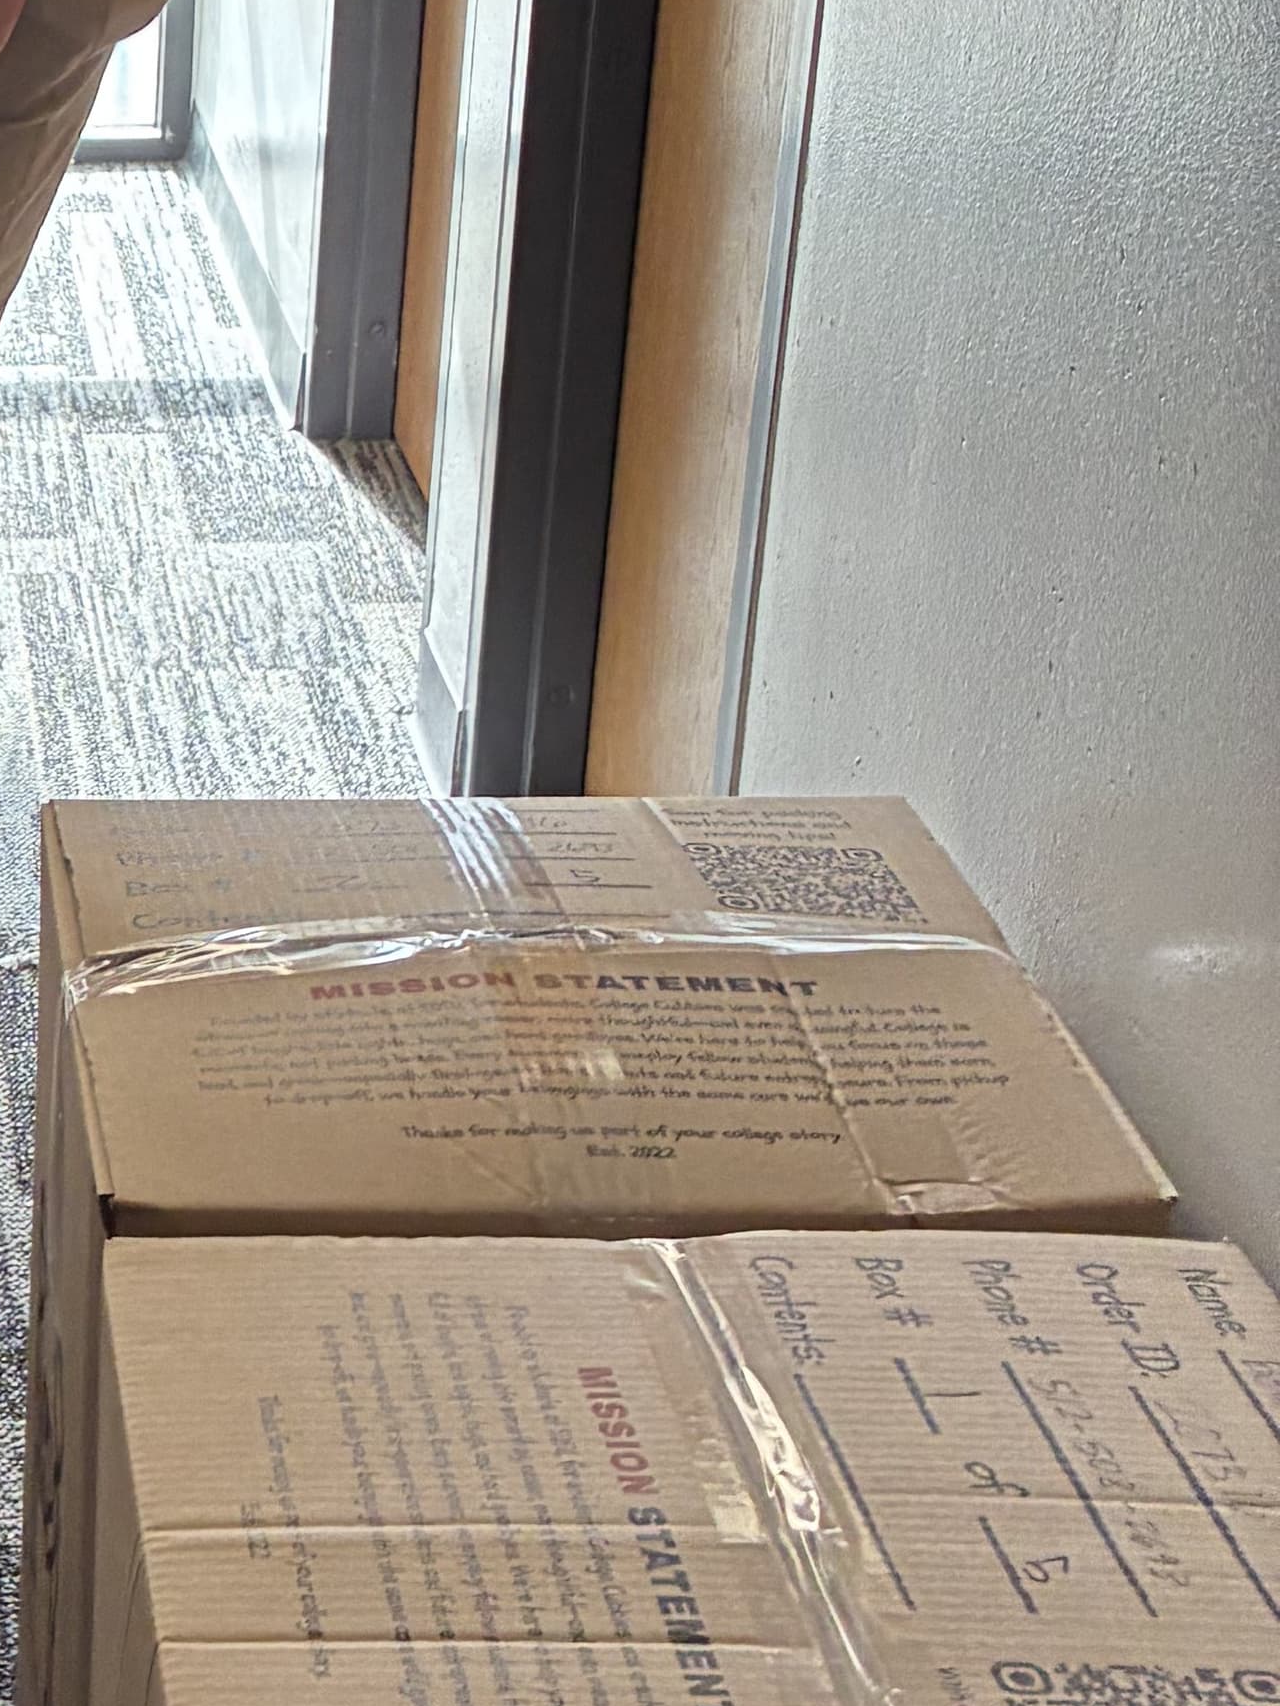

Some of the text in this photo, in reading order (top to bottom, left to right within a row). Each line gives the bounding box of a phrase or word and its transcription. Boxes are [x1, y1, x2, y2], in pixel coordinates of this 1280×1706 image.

[308, 972, 824, 1000] MISSION STATEMENT
[399, 1124, 466, 1139] Thanks
[465, 1122, 499, 1138] for
[500, 1123, 570, 1141] making
[597, 1124, 643, 1139] part
[642, 1124, 671, 1138] of
[668, 1125, 721, 1141] your
[747, 1255, 830, 1366] Contents:
[963, 1259, 1030, 1327] Phone
[1011, 1335, 1062, 1356] #
[1074, 1262, 1181, 1380] Order ID:
[576, 1366, 660, 1496] MISSION
[855, 1256, 904, 1301] Box
[882, 1308, 934, 1329] #
[963, 1460, 1030, 1499] of
[1023, 1553, 1070, 1585] 5
